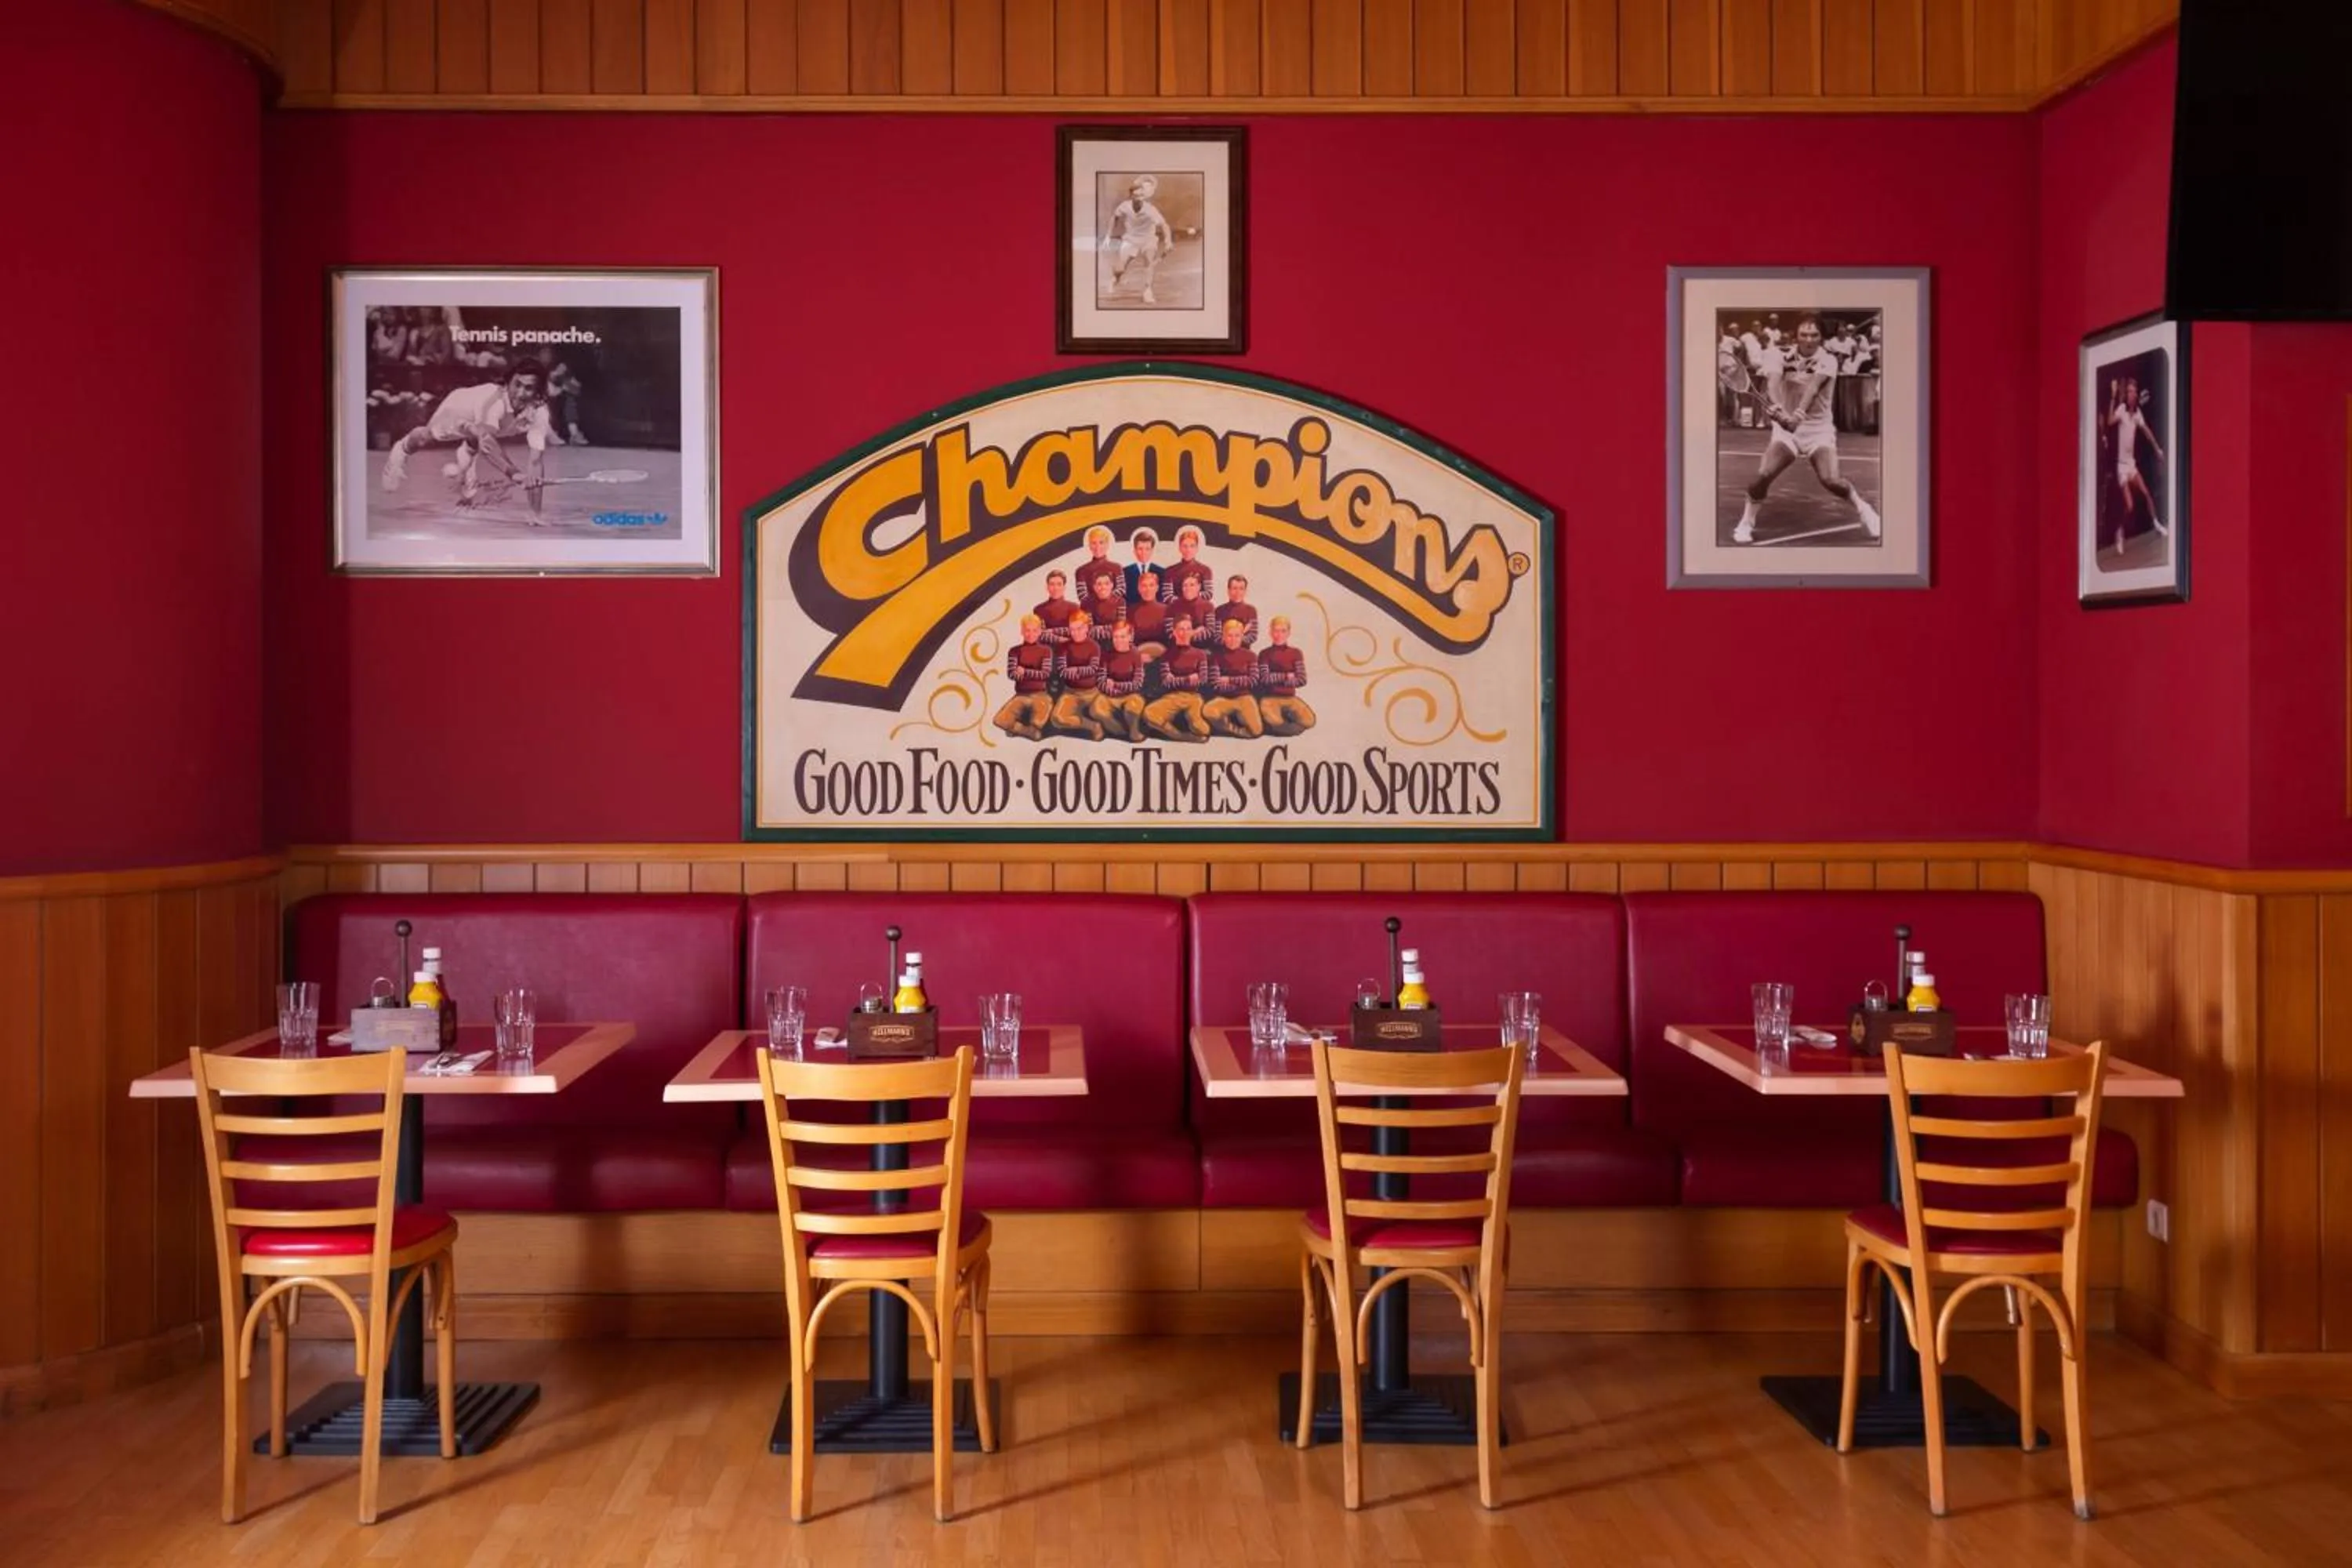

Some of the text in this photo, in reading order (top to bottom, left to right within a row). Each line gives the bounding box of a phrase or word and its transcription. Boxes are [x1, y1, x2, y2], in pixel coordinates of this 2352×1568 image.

[448, 325, 601, 347] Tennis panache.
[592, 512, 645, 525] adidas
[789, 416, 1513, 710] Champions
[794, 745, 1501, 815] GOOD FOOD GOOD TIMES GOOD SPORTS
